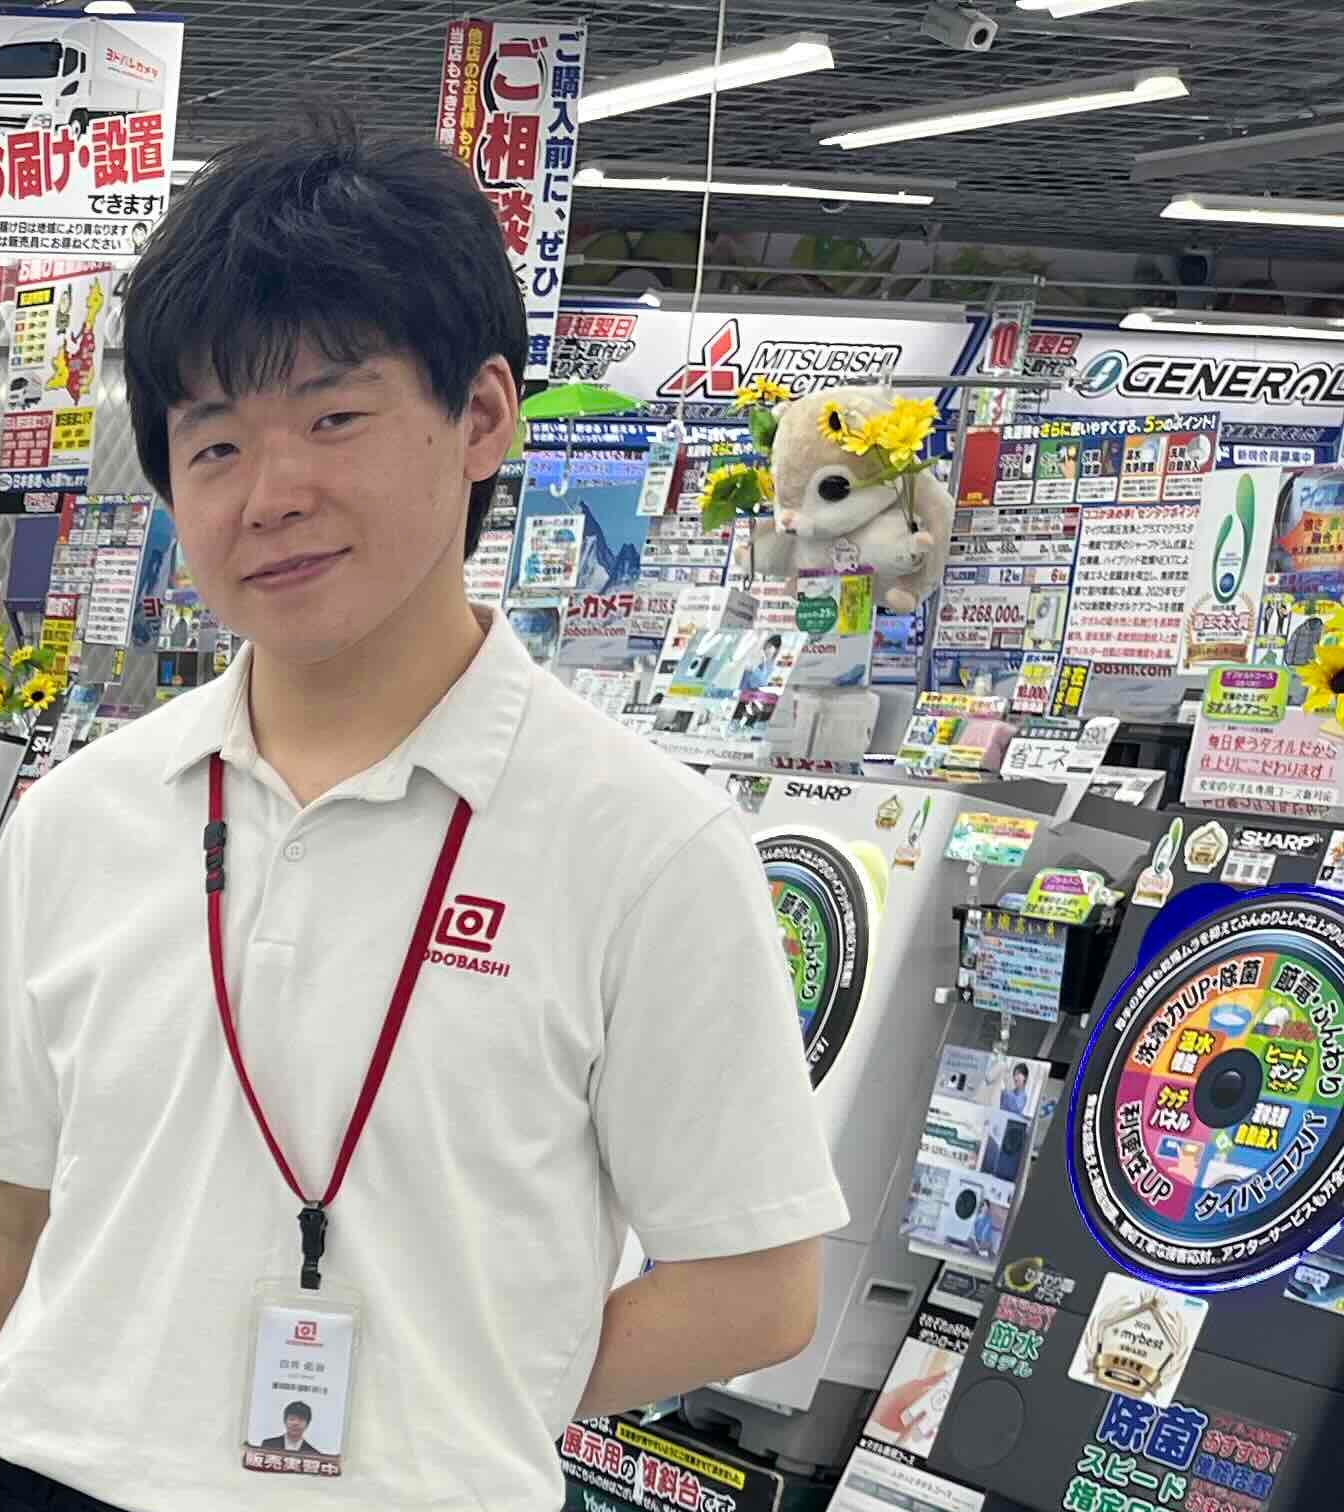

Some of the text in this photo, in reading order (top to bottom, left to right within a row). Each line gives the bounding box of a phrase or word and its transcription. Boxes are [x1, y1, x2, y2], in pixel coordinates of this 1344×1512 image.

[755, 348, 894, 372] MITSUBISHI
[784, 783, 852, 802] SHARP
[1241, 833, 1313, 850] SHARP
[1134, 957, 1263, 1067] 洗浄力UP・除菌
[1119, 1103, 1174, 1206] 利便性UP
[1194, 1110, 1327, 1220] タイパ・コスパ
[987, 1321, 1043, 1361] 節水
[1120, 1329, 1164, 1350] mybest
[1076, 1443, 1186, 1503] スピード
